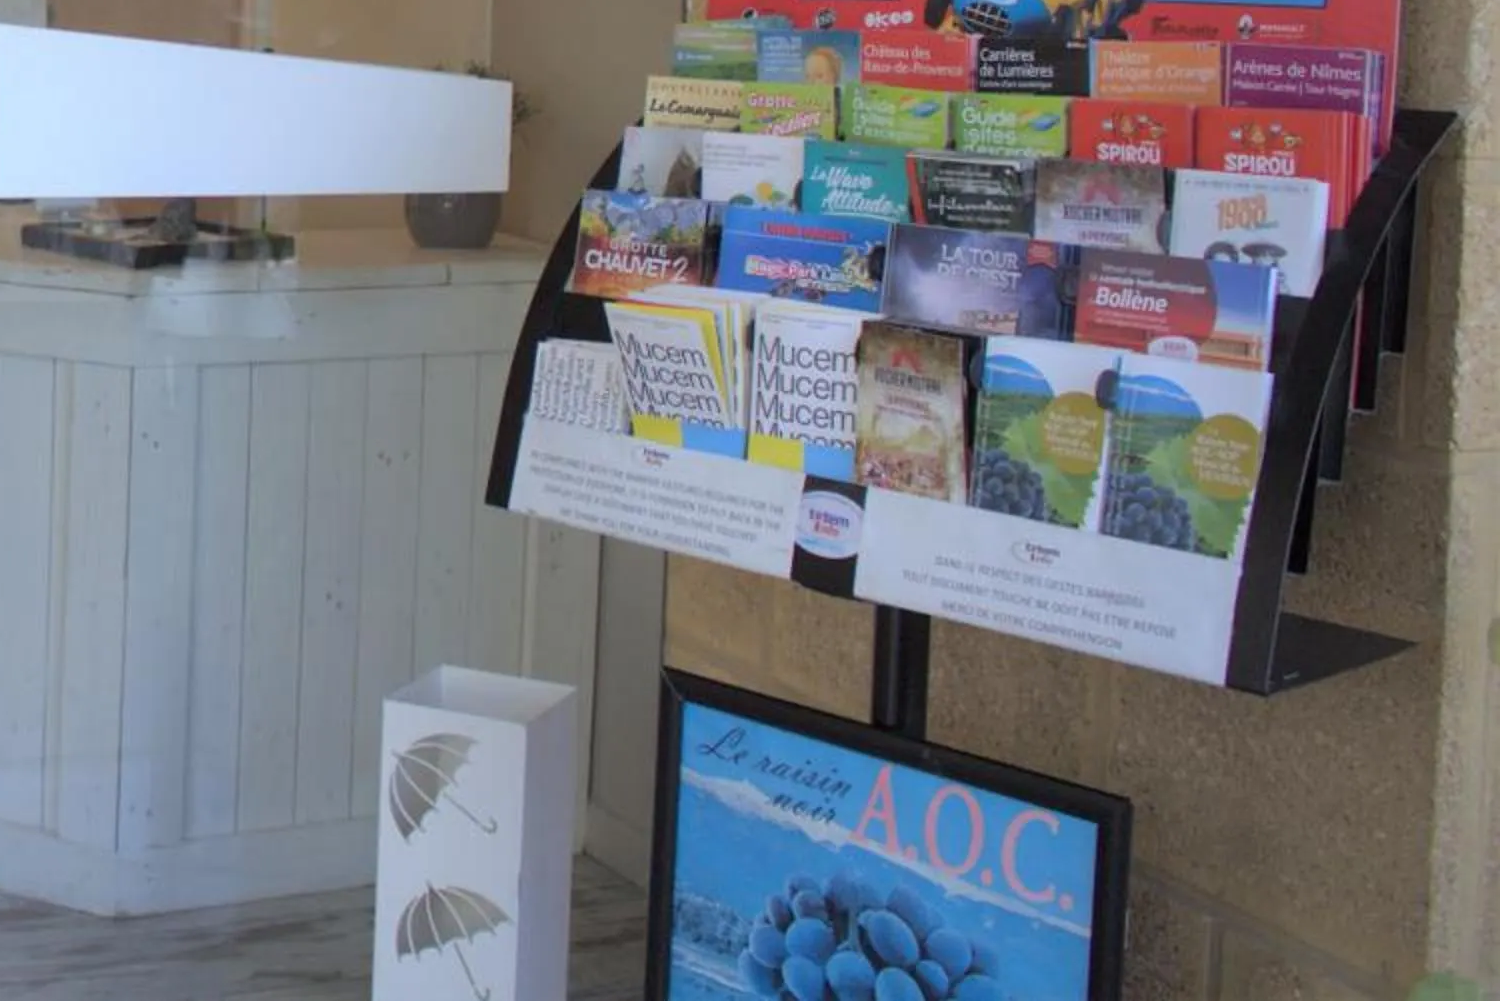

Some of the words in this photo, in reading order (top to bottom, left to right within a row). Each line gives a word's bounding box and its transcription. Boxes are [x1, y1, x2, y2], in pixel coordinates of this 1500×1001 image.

[864, 44, 909, 60] Château
[912, 46, 931, 60] des
[979, 48, 1035, 62] Carrières
[979, 63, 995, 78] de
[997, 63, 1054, 78] Lumières
[1233, 59, 1283, 76] Arènes
[1287, 62, 1305, 77] de
[1310, 62, 1362, 81] Nîmes
[963, 106, 1017, 127] Guide
[1097, 142, 1161, 164] SPIROU
[1224, 152, 1296, 175] SPIROU
[610, 239, 668, 257] GROTTE
[941, 243, 965, 264] LA
[968, 248, 1020, 270] TOUR
[585, 248, 670, 280] CHAUVET
[670, 255, 689, 283] 2
[937, 262, 958, 278] DE
[964, 268, 1023, 291] CREST
[1095, 285, 1169, 313] Bollène
[614, 329, 708, 368] Mucem
[758, 333, 857, 374] Mucem
[621, 355, 715, 391] Mucem
[757, 363, 857, 403] Mucem
[628, 379, 722, 414] Mucem
[755, 391, 856, 432] Mucem
[699, 726, 749, 765] Le
[752, 756, 854, 800] raisin
[770, 792, 837, 826] noir
[846, 762, 1075, 912] A.O.C.
